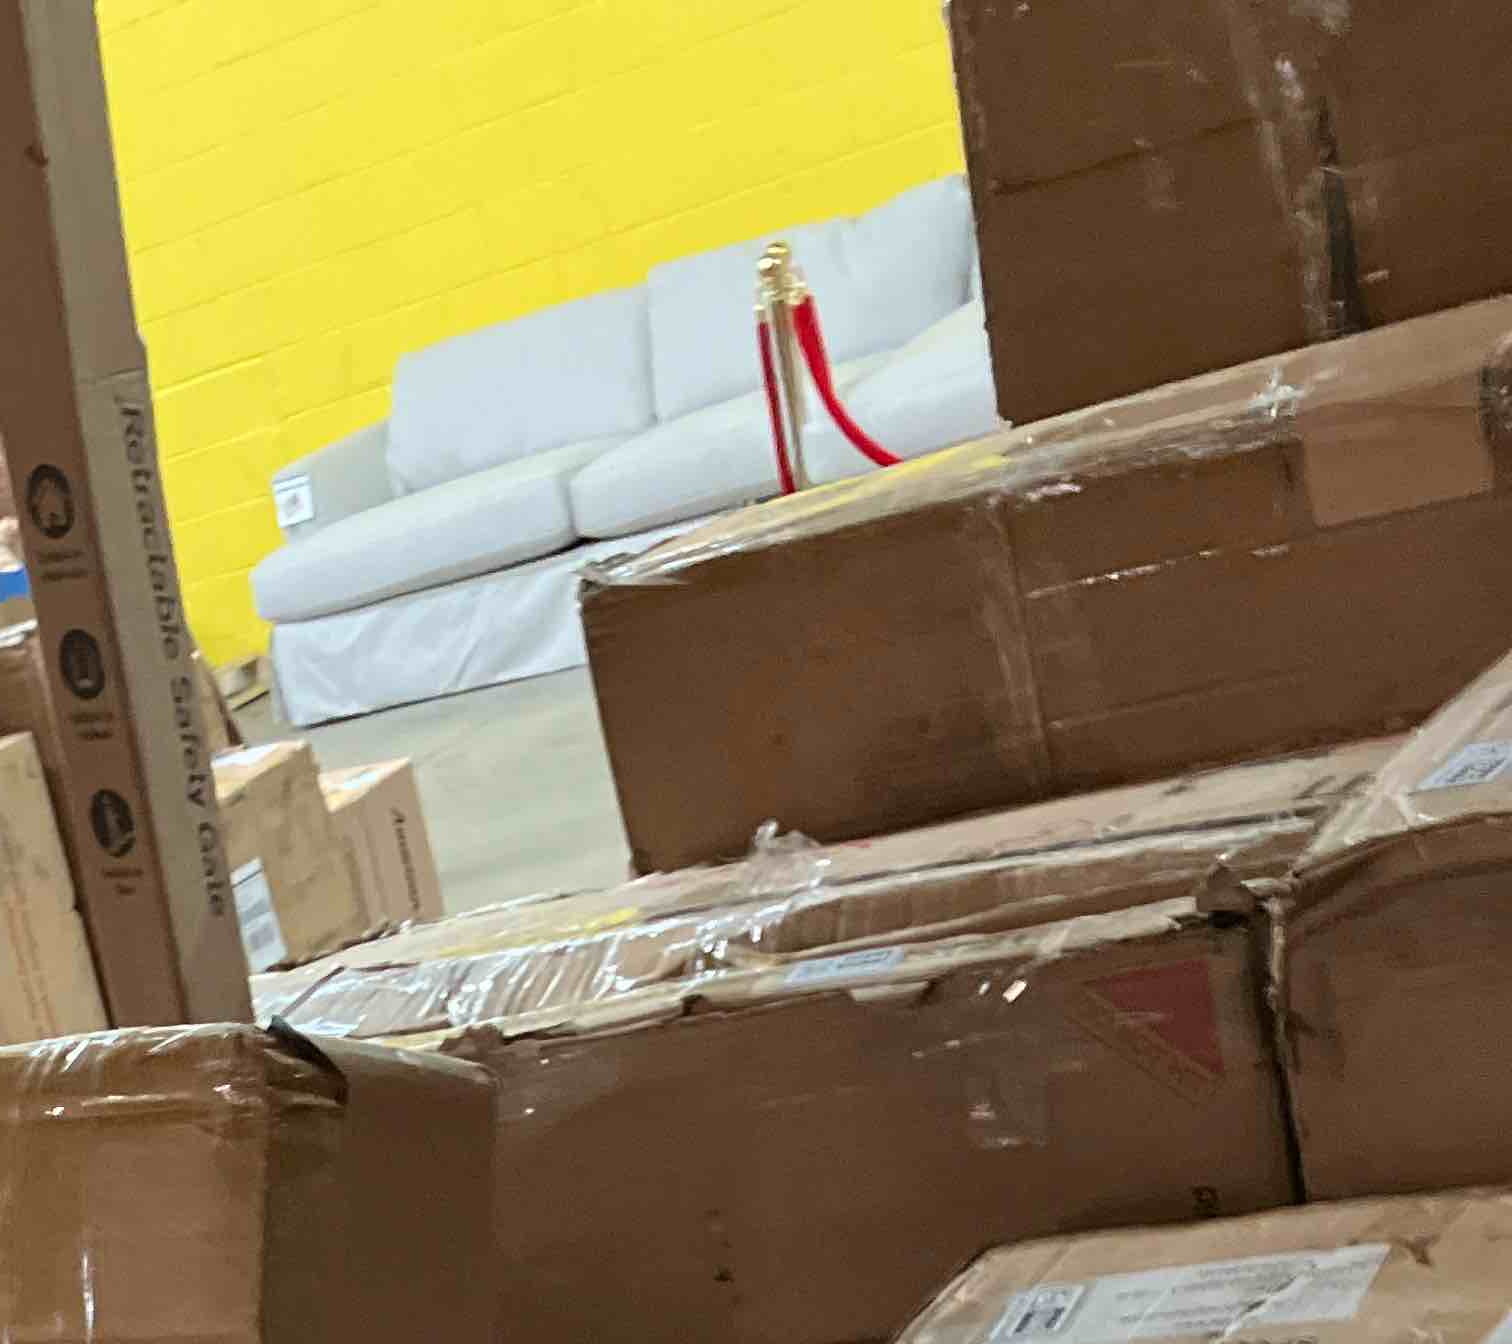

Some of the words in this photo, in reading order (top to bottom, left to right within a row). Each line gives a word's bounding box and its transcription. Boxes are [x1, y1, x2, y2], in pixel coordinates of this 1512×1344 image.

[122, 403, 180, 660] Retractable
[171, 675, 209, 808] Safety
[197, 820, 224, 917] Gate
